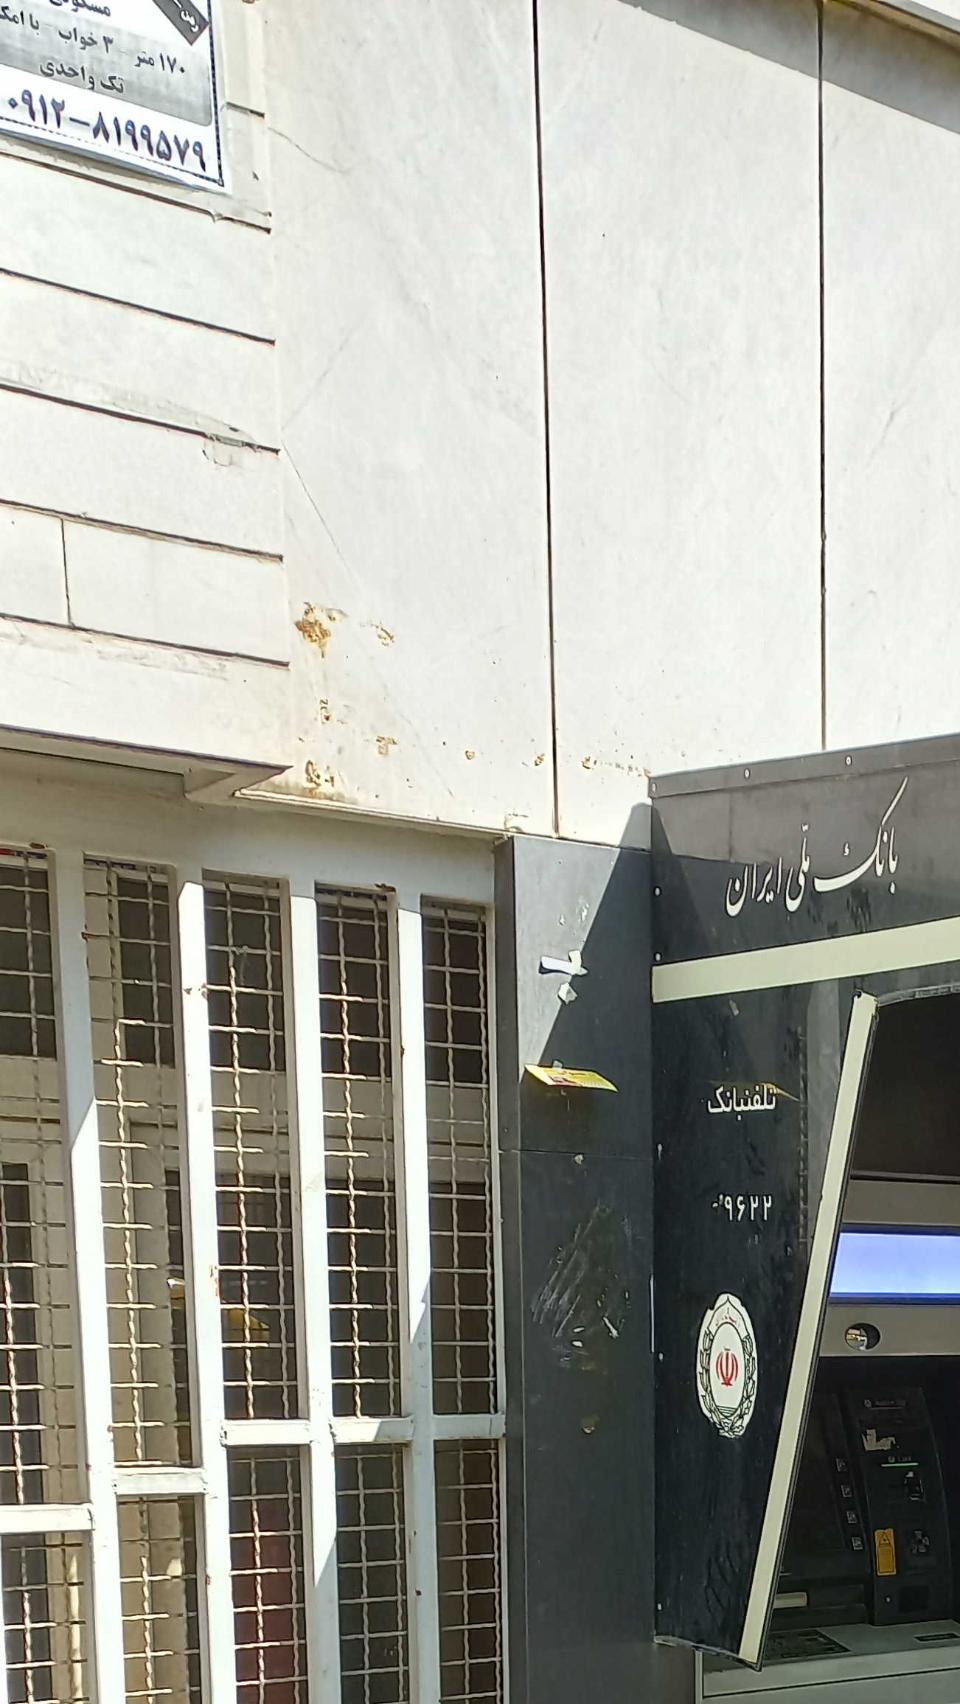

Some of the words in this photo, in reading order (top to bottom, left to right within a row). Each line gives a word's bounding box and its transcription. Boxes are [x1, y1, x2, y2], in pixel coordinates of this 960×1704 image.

[58, 27, 98, 50] خواب
[134, 52, 156, 69] متر
[159, 53, 186, 74] ۱۷۰
[40, 63, 96, 91] واحدی
[100, 77, 125, 94] تک
[813, 776, 909, 896] بانک
[724, 856, 783, 918] ایران
